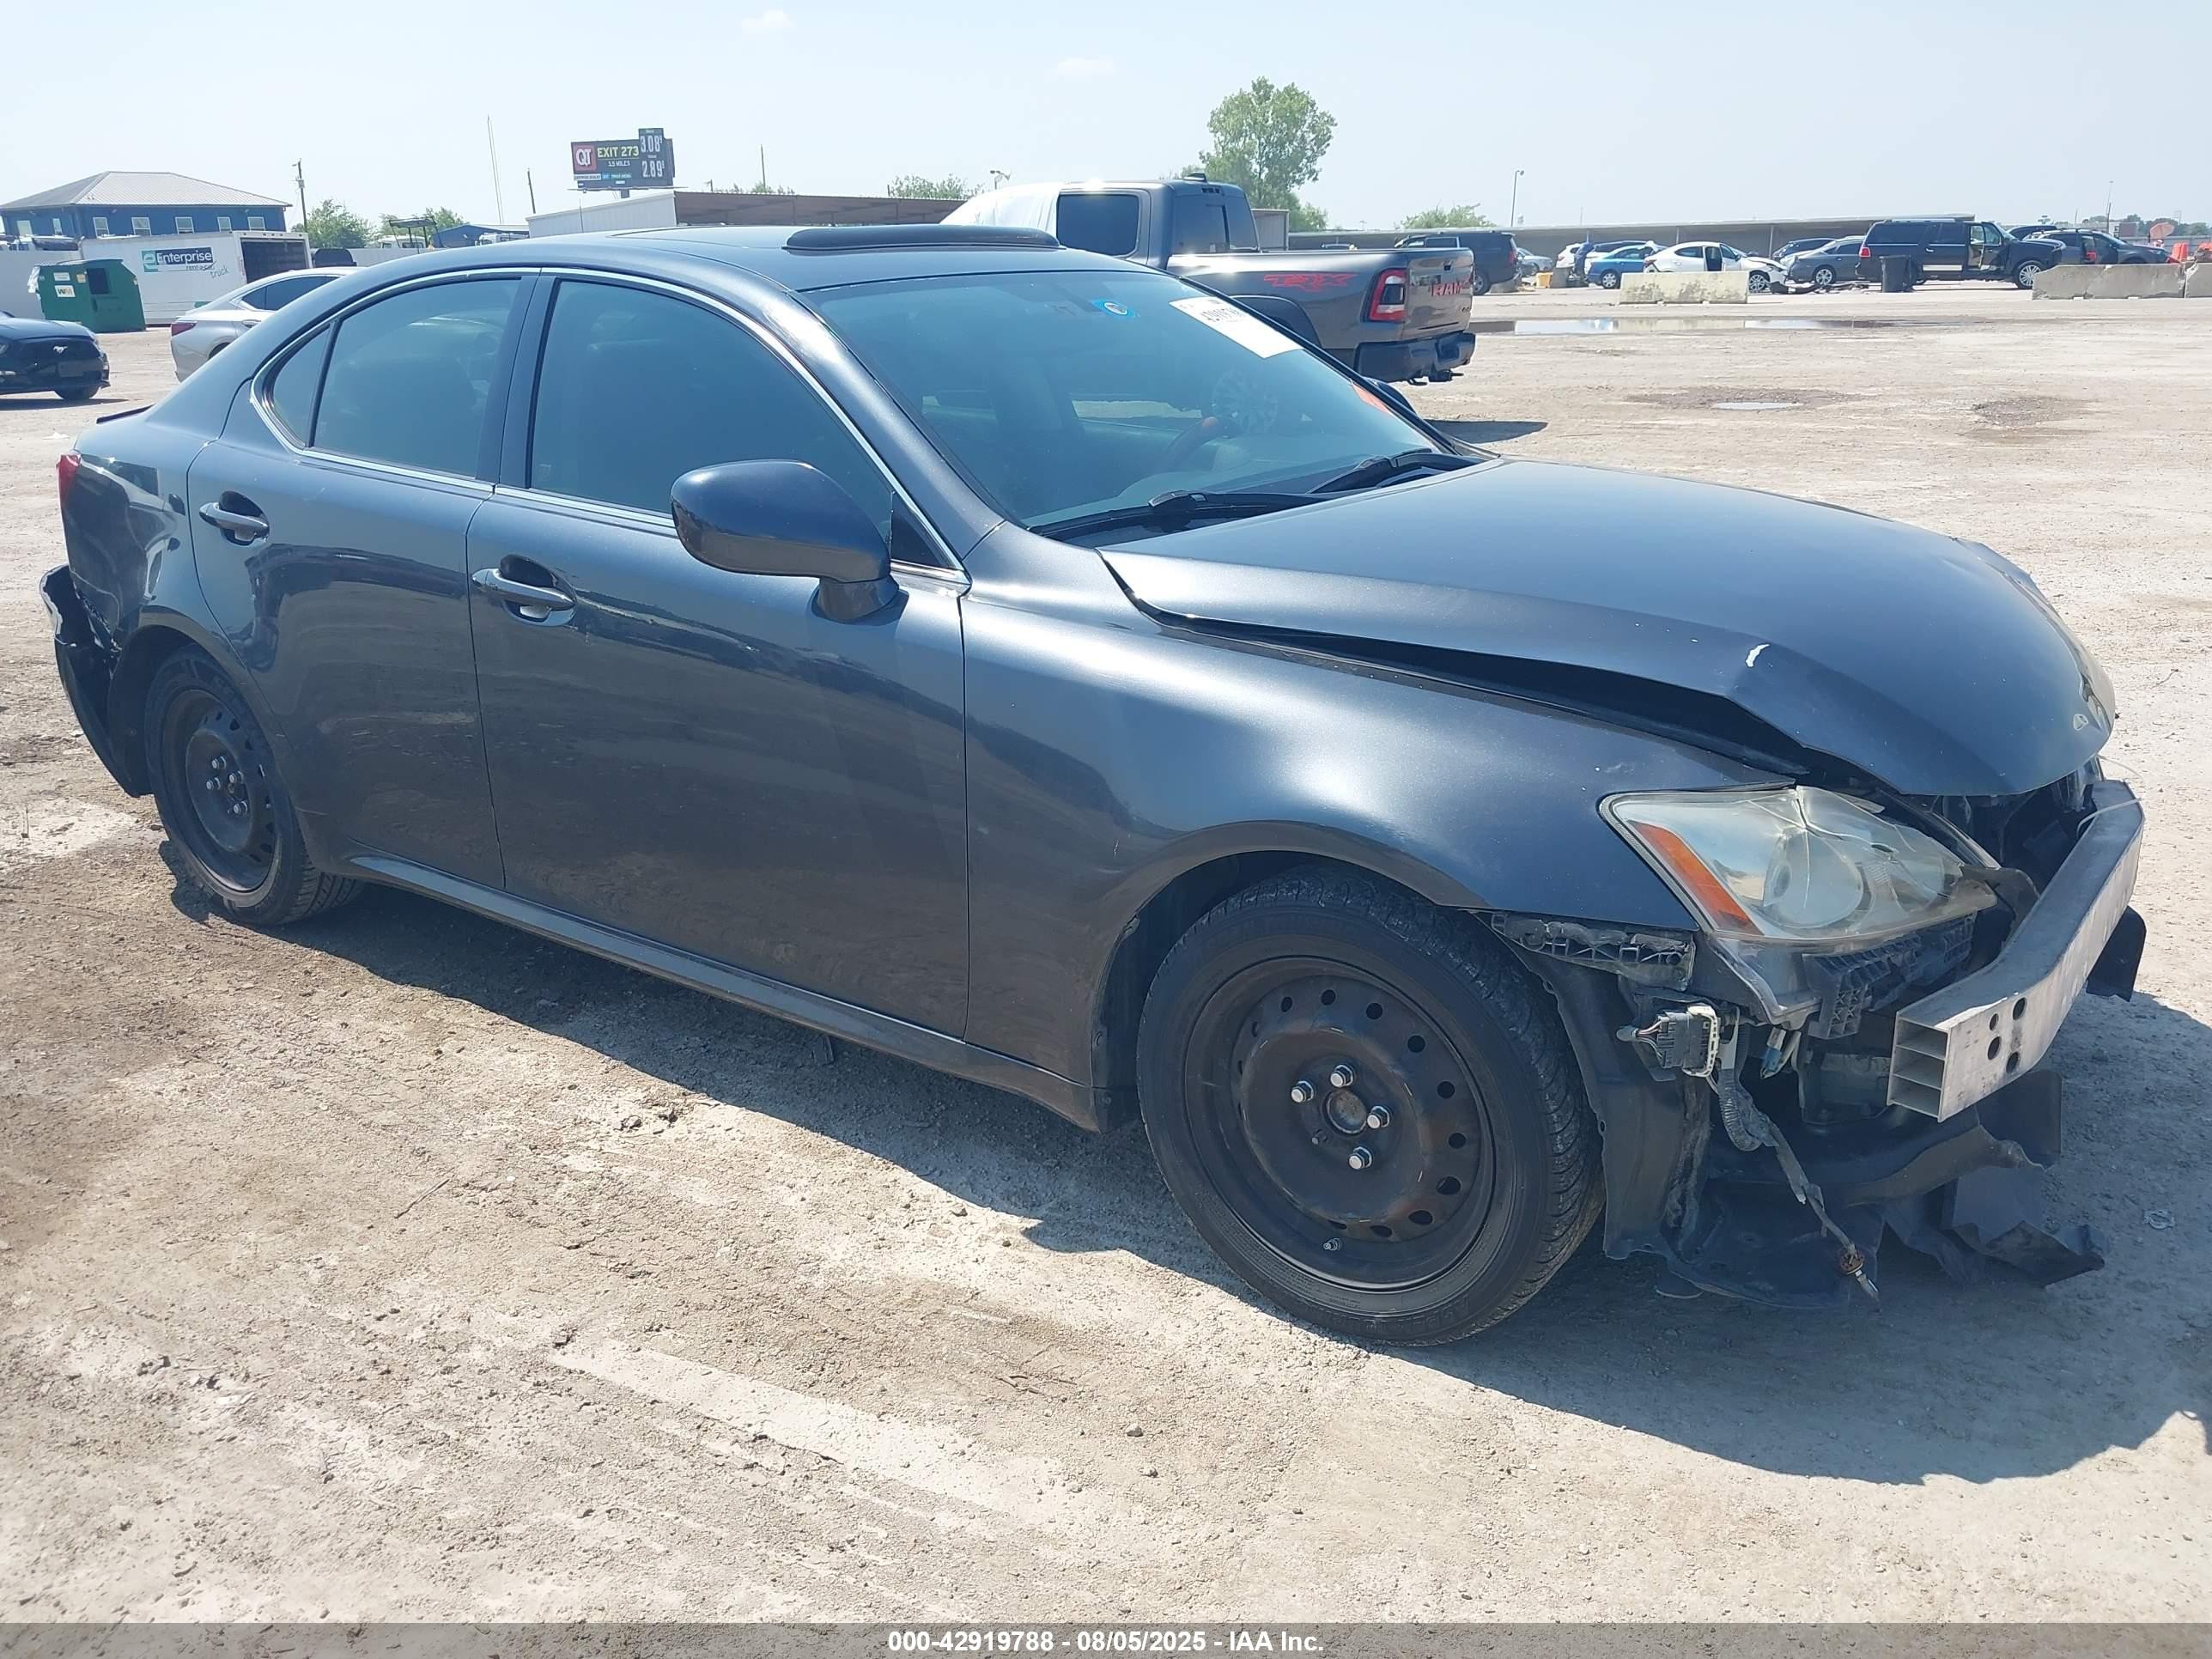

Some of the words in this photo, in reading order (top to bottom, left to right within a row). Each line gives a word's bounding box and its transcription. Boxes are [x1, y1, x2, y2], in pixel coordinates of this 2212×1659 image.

[575, 148, 592, 167] QT
[597, 146, 619, 158] EXIT
[621, 146, 640, 157] 273
[156, 250, 213, 265] Enterprise
[1431, 280, 1464, 296] RAM
